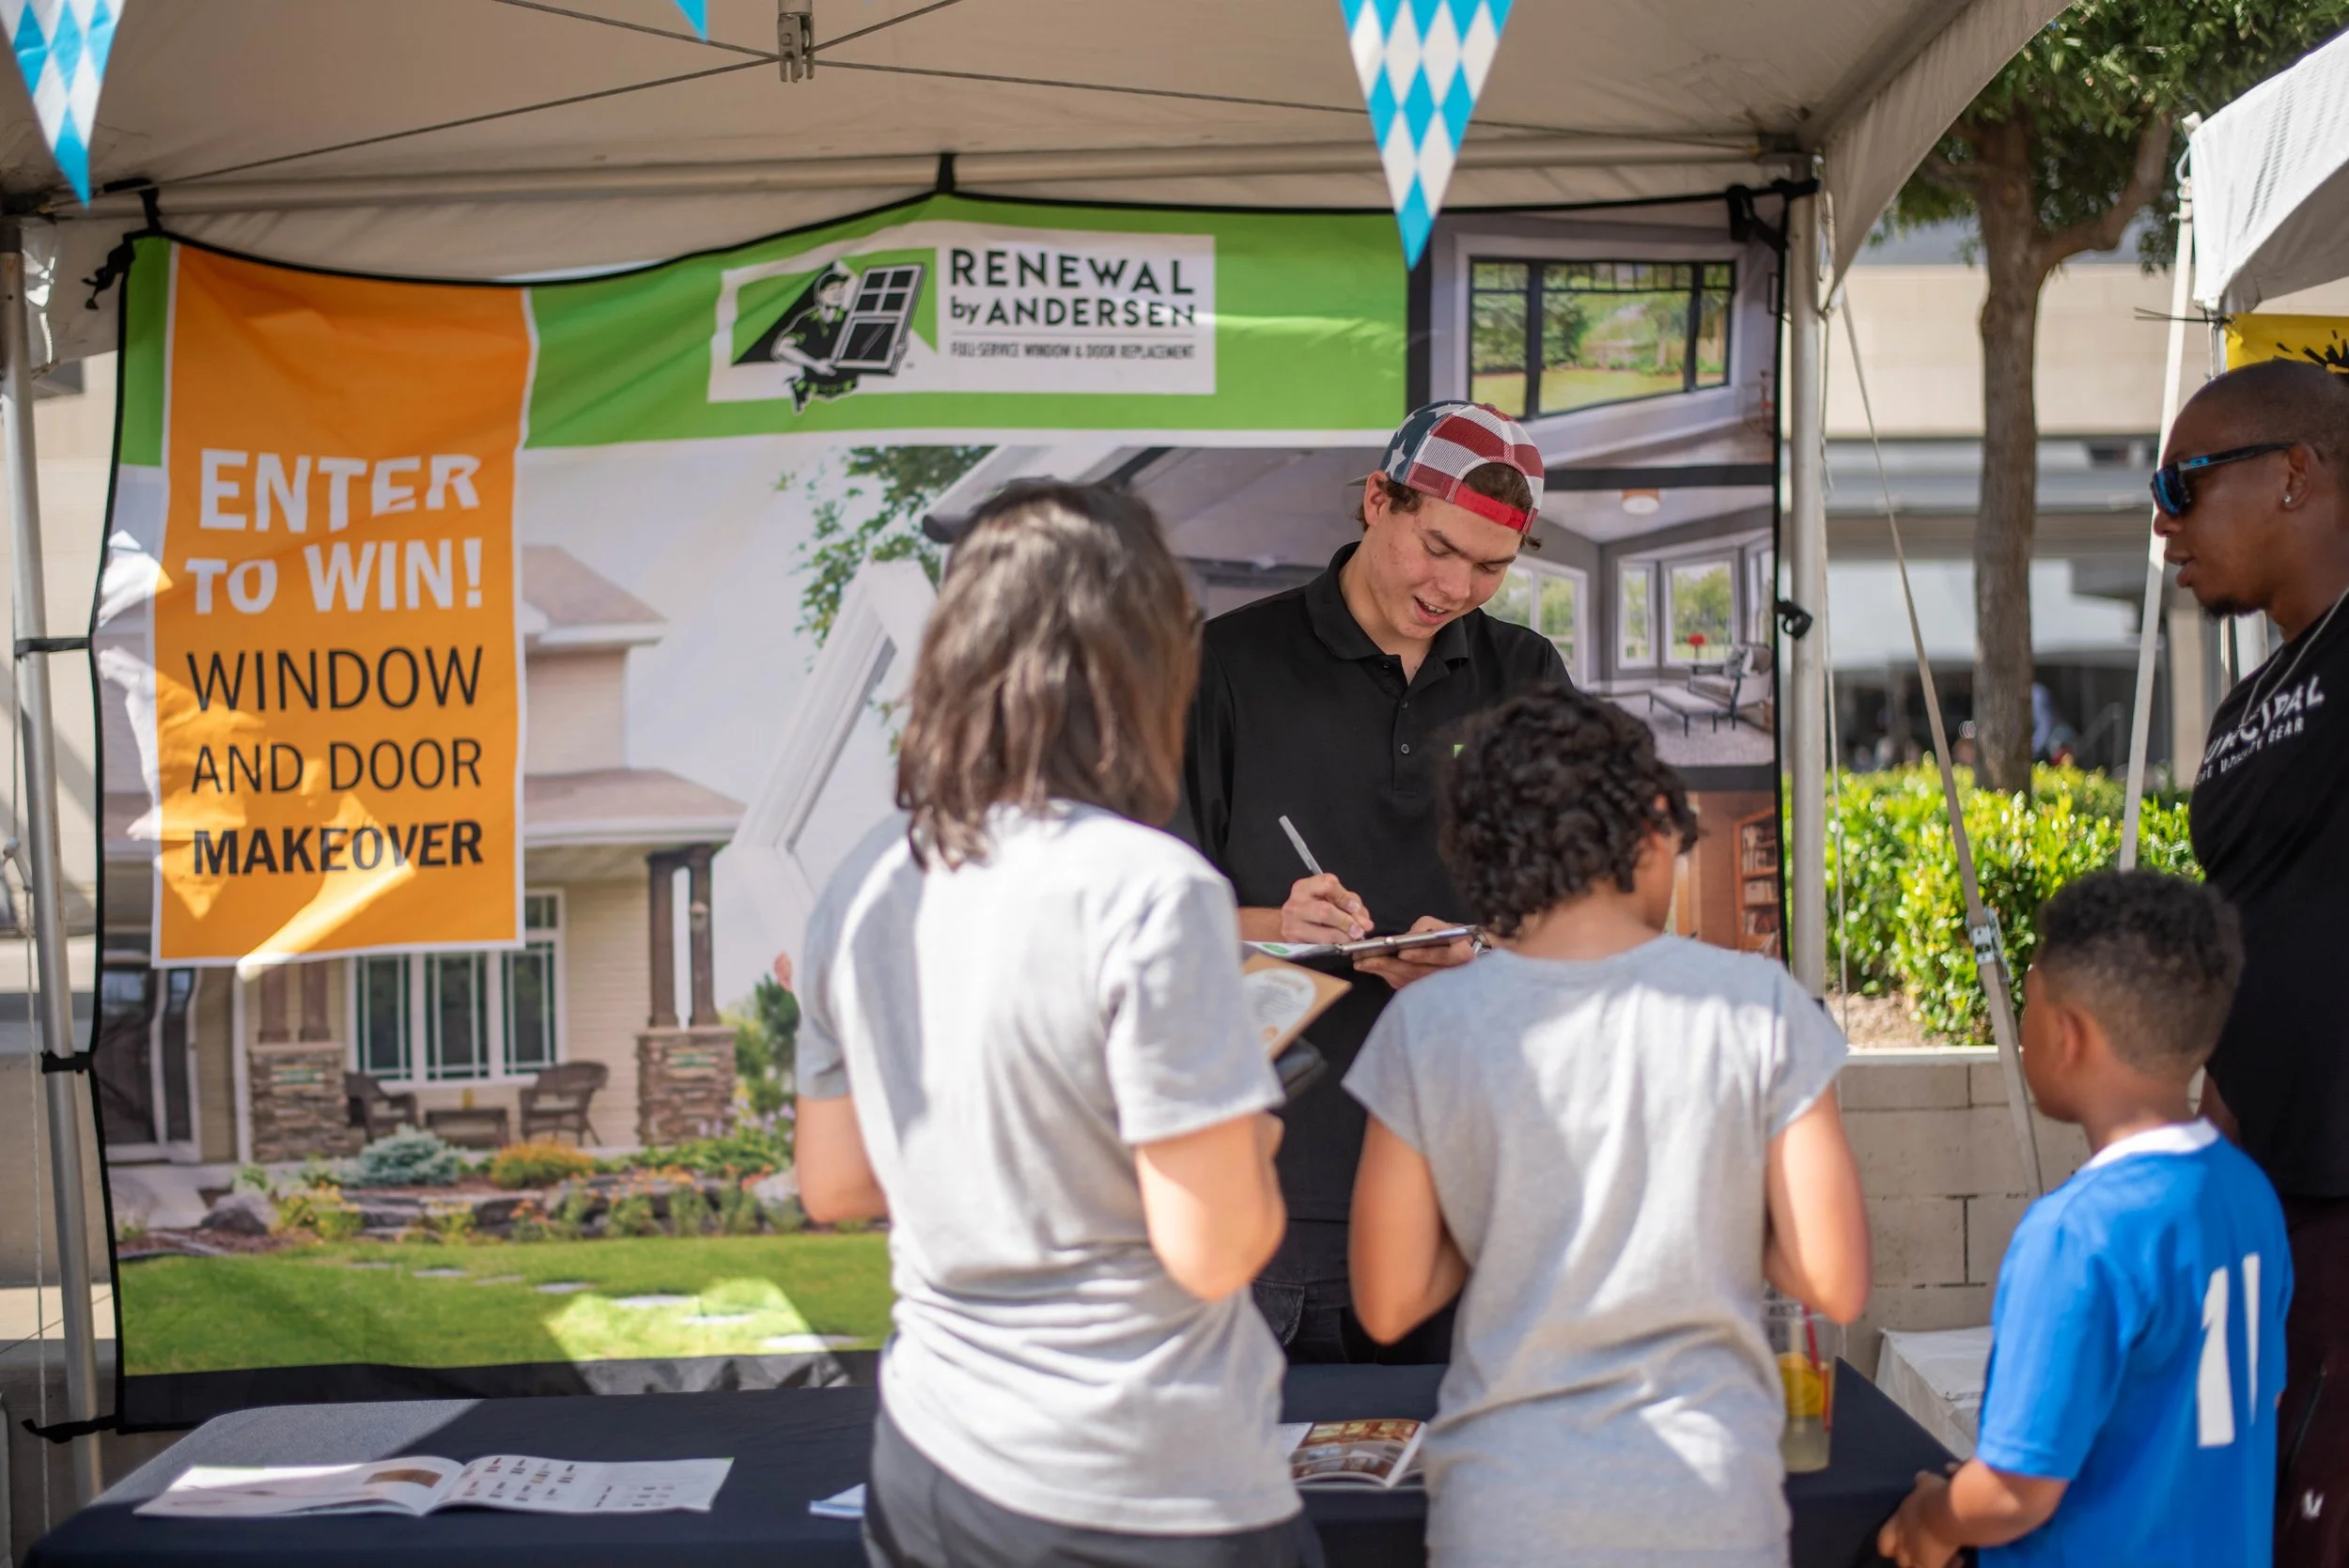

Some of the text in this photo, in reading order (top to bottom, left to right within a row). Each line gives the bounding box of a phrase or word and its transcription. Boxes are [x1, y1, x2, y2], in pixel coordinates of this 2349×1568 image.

[950, 248, 1196, 295] RENEWAL
[950, 295, 1196, 328] by ANDERSEN
[1024, 344, 1071, 359] WINDOW
[1086, 344, 1116, 359] DOOR
[1120, 345, 1196, 360] REPLACEMENT
[199, 448, 481, 534] ENTER
[185, 537, 483, 614] TO WIN!
[186, 644, 483, 712] WINDOW
[191, 737, 482, 795] AND DOOR
[193, 818, 484, 877] MAKEOVER
[2197, 1252, 2260, 1449] 11
